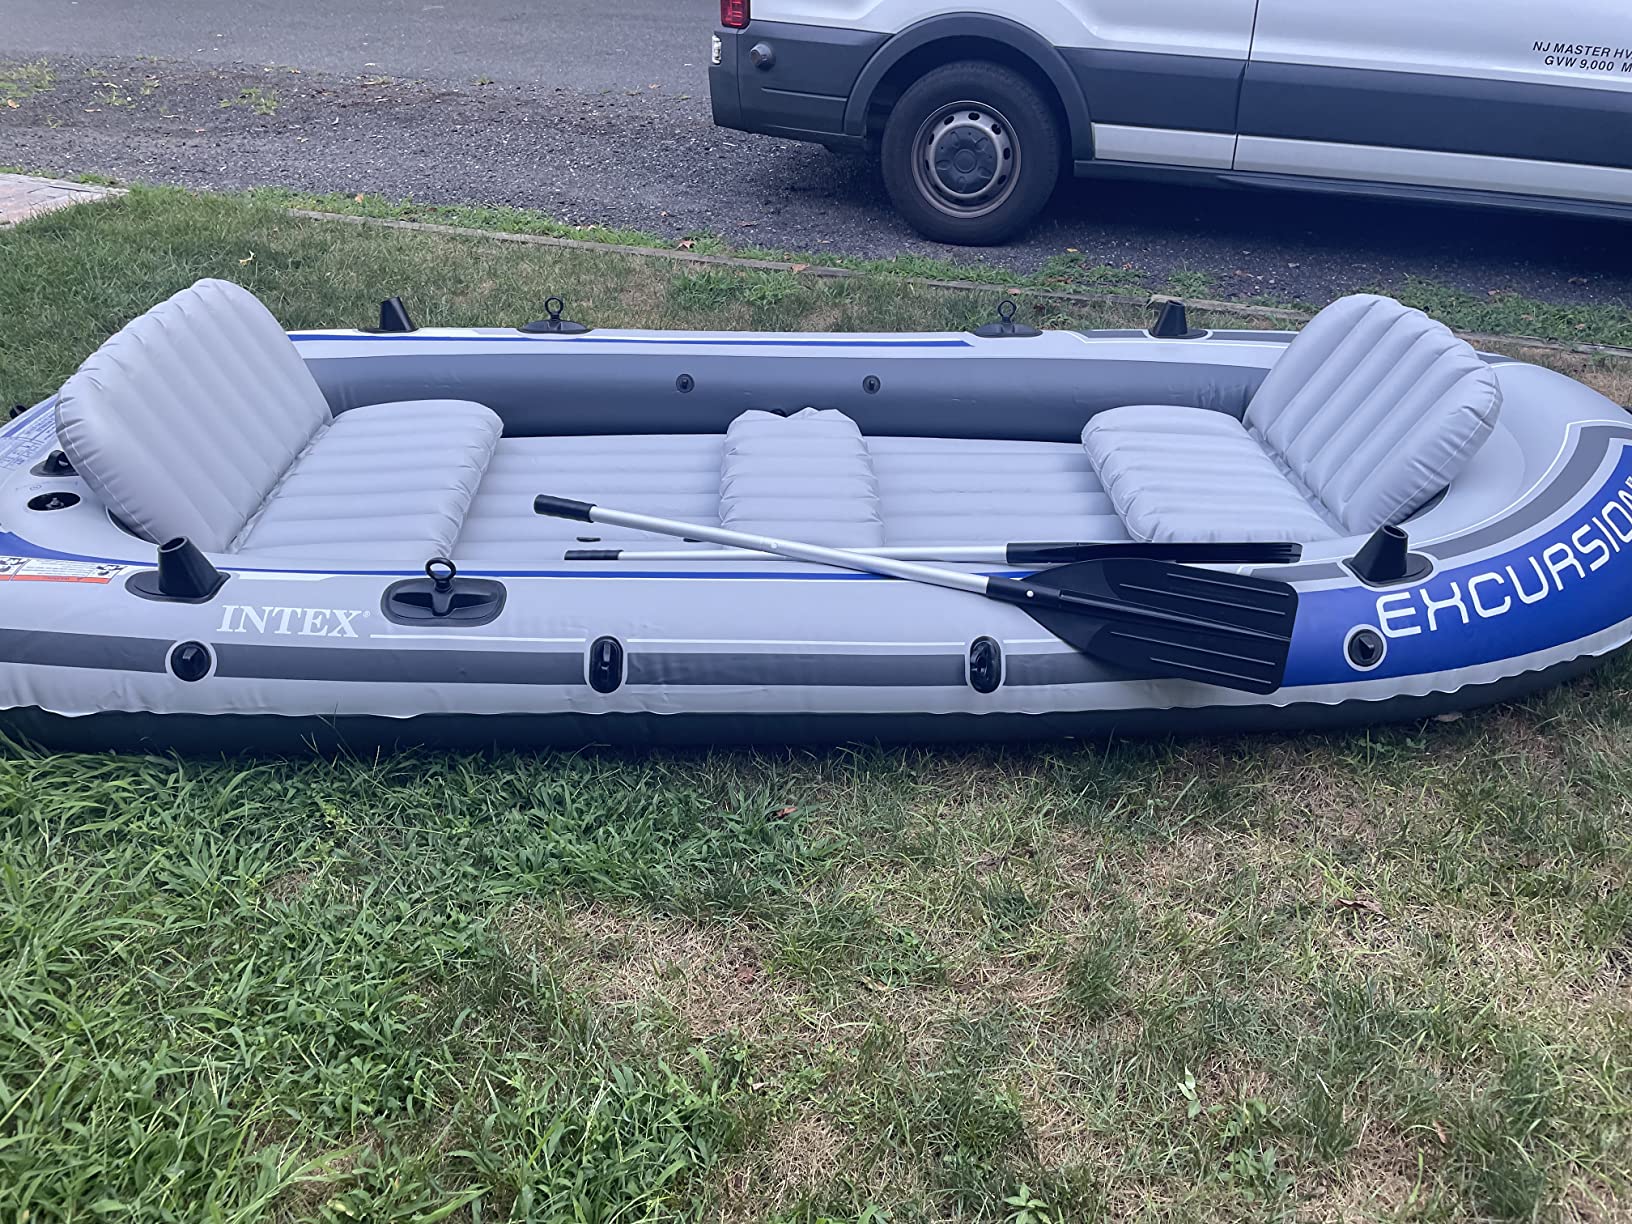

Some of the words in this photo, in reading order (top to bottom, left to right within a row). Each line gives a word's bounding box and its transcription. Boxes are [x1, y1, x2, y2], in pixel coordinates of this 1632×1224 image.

[1532, 41, 1551, 52] NJ
[1553, 43, 1611, 58] MASTER
[1613, 48, 1632, 60] HV
[1544, 55, 1577, 67] GVW
[1579, 59, 1615, 71] 9,000
